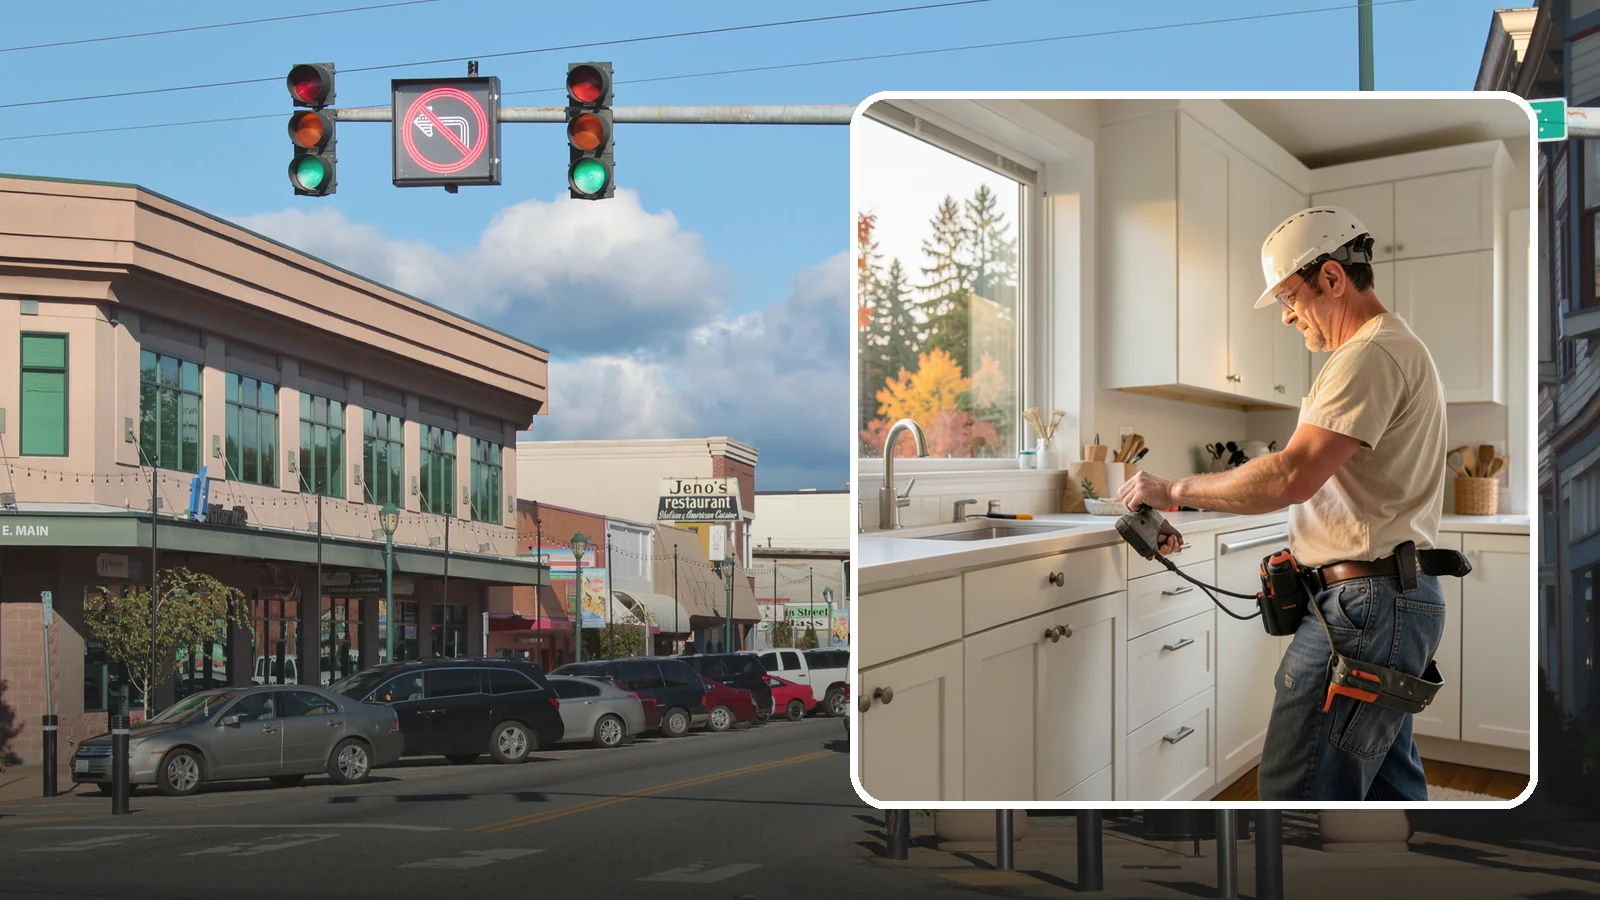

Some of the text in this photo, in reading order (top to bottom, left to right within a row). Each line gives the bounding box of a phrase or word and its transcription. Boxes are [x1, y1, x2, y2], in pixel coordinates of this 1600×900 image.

[669, 479, 728, 495] Jeno's
[665, 496, 731, 509] restaurant
[658, 510, 682, 520] Italian
[685, 509, 715, 519] American
[714, 509, 737, 519] Cuisine
[2, 525, 49, 536] E. MAIN
[797, 607, 828, 617] Street
[791, 619, 824, 627] lass
